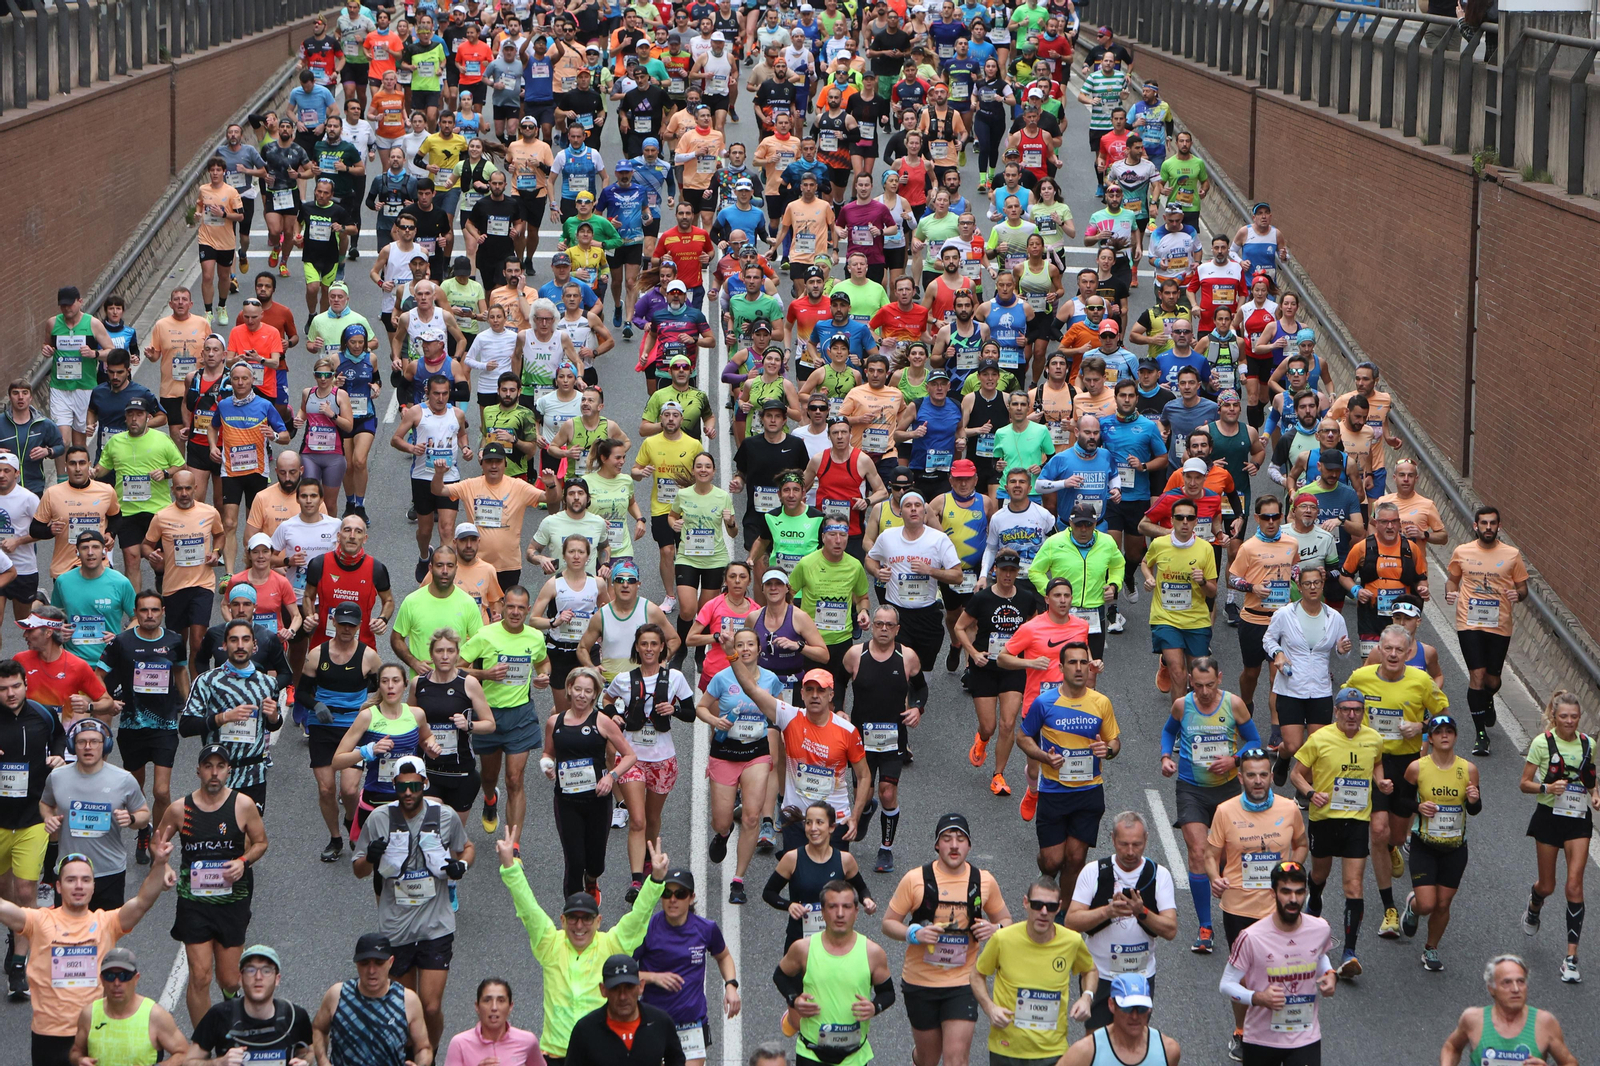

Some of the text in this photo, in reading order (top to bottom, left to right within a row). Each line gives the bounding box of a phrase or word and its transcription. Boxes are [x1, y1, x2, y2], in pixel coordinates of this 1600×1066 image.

[535, 353, 551, 361] JMT
[780, 529, 805, 539] sano
[333, 588, 359, 597] vicenza
[333, 593, 359, 601] runners
[991, 614, 1024, 625] Chicago
[1055, 716, 1098, 731] agustinos
[568, 759, 590, 767] ZURICH
[1431, 786, 1459, 797] teika
[83, 803, 107, 811] ZURICH
[81, 814, 99, 822] 11020
[406, 870, 429, 879] ZURICH
[66, 947, 93, 955] ZURICH
[1032, 991, 1057, 999] ZURICH
[1029, 1004, 1048, 1012] 10009
[253, 1051, 281, 1060] ZURICH
[1497, 1051, 1526, 1060] ZURICH
